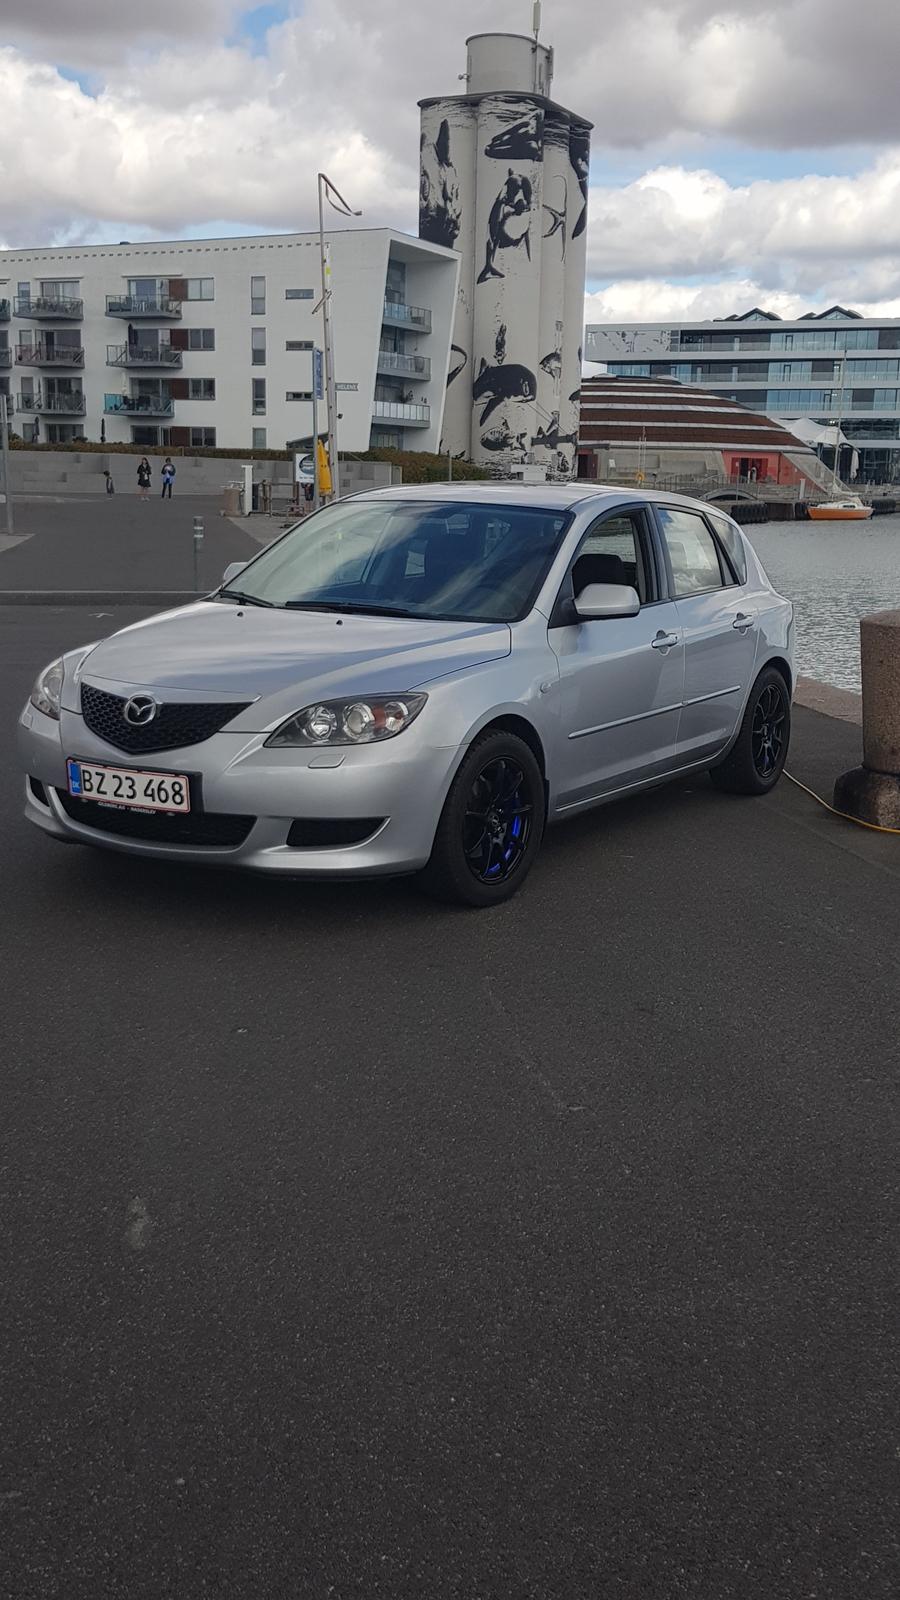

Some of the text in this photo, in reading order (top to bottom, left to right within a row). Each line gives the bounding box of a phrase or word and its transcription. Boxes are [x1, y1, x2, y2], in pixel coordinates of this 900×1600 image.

[82, 770, 184, 805] BZ 23 468
